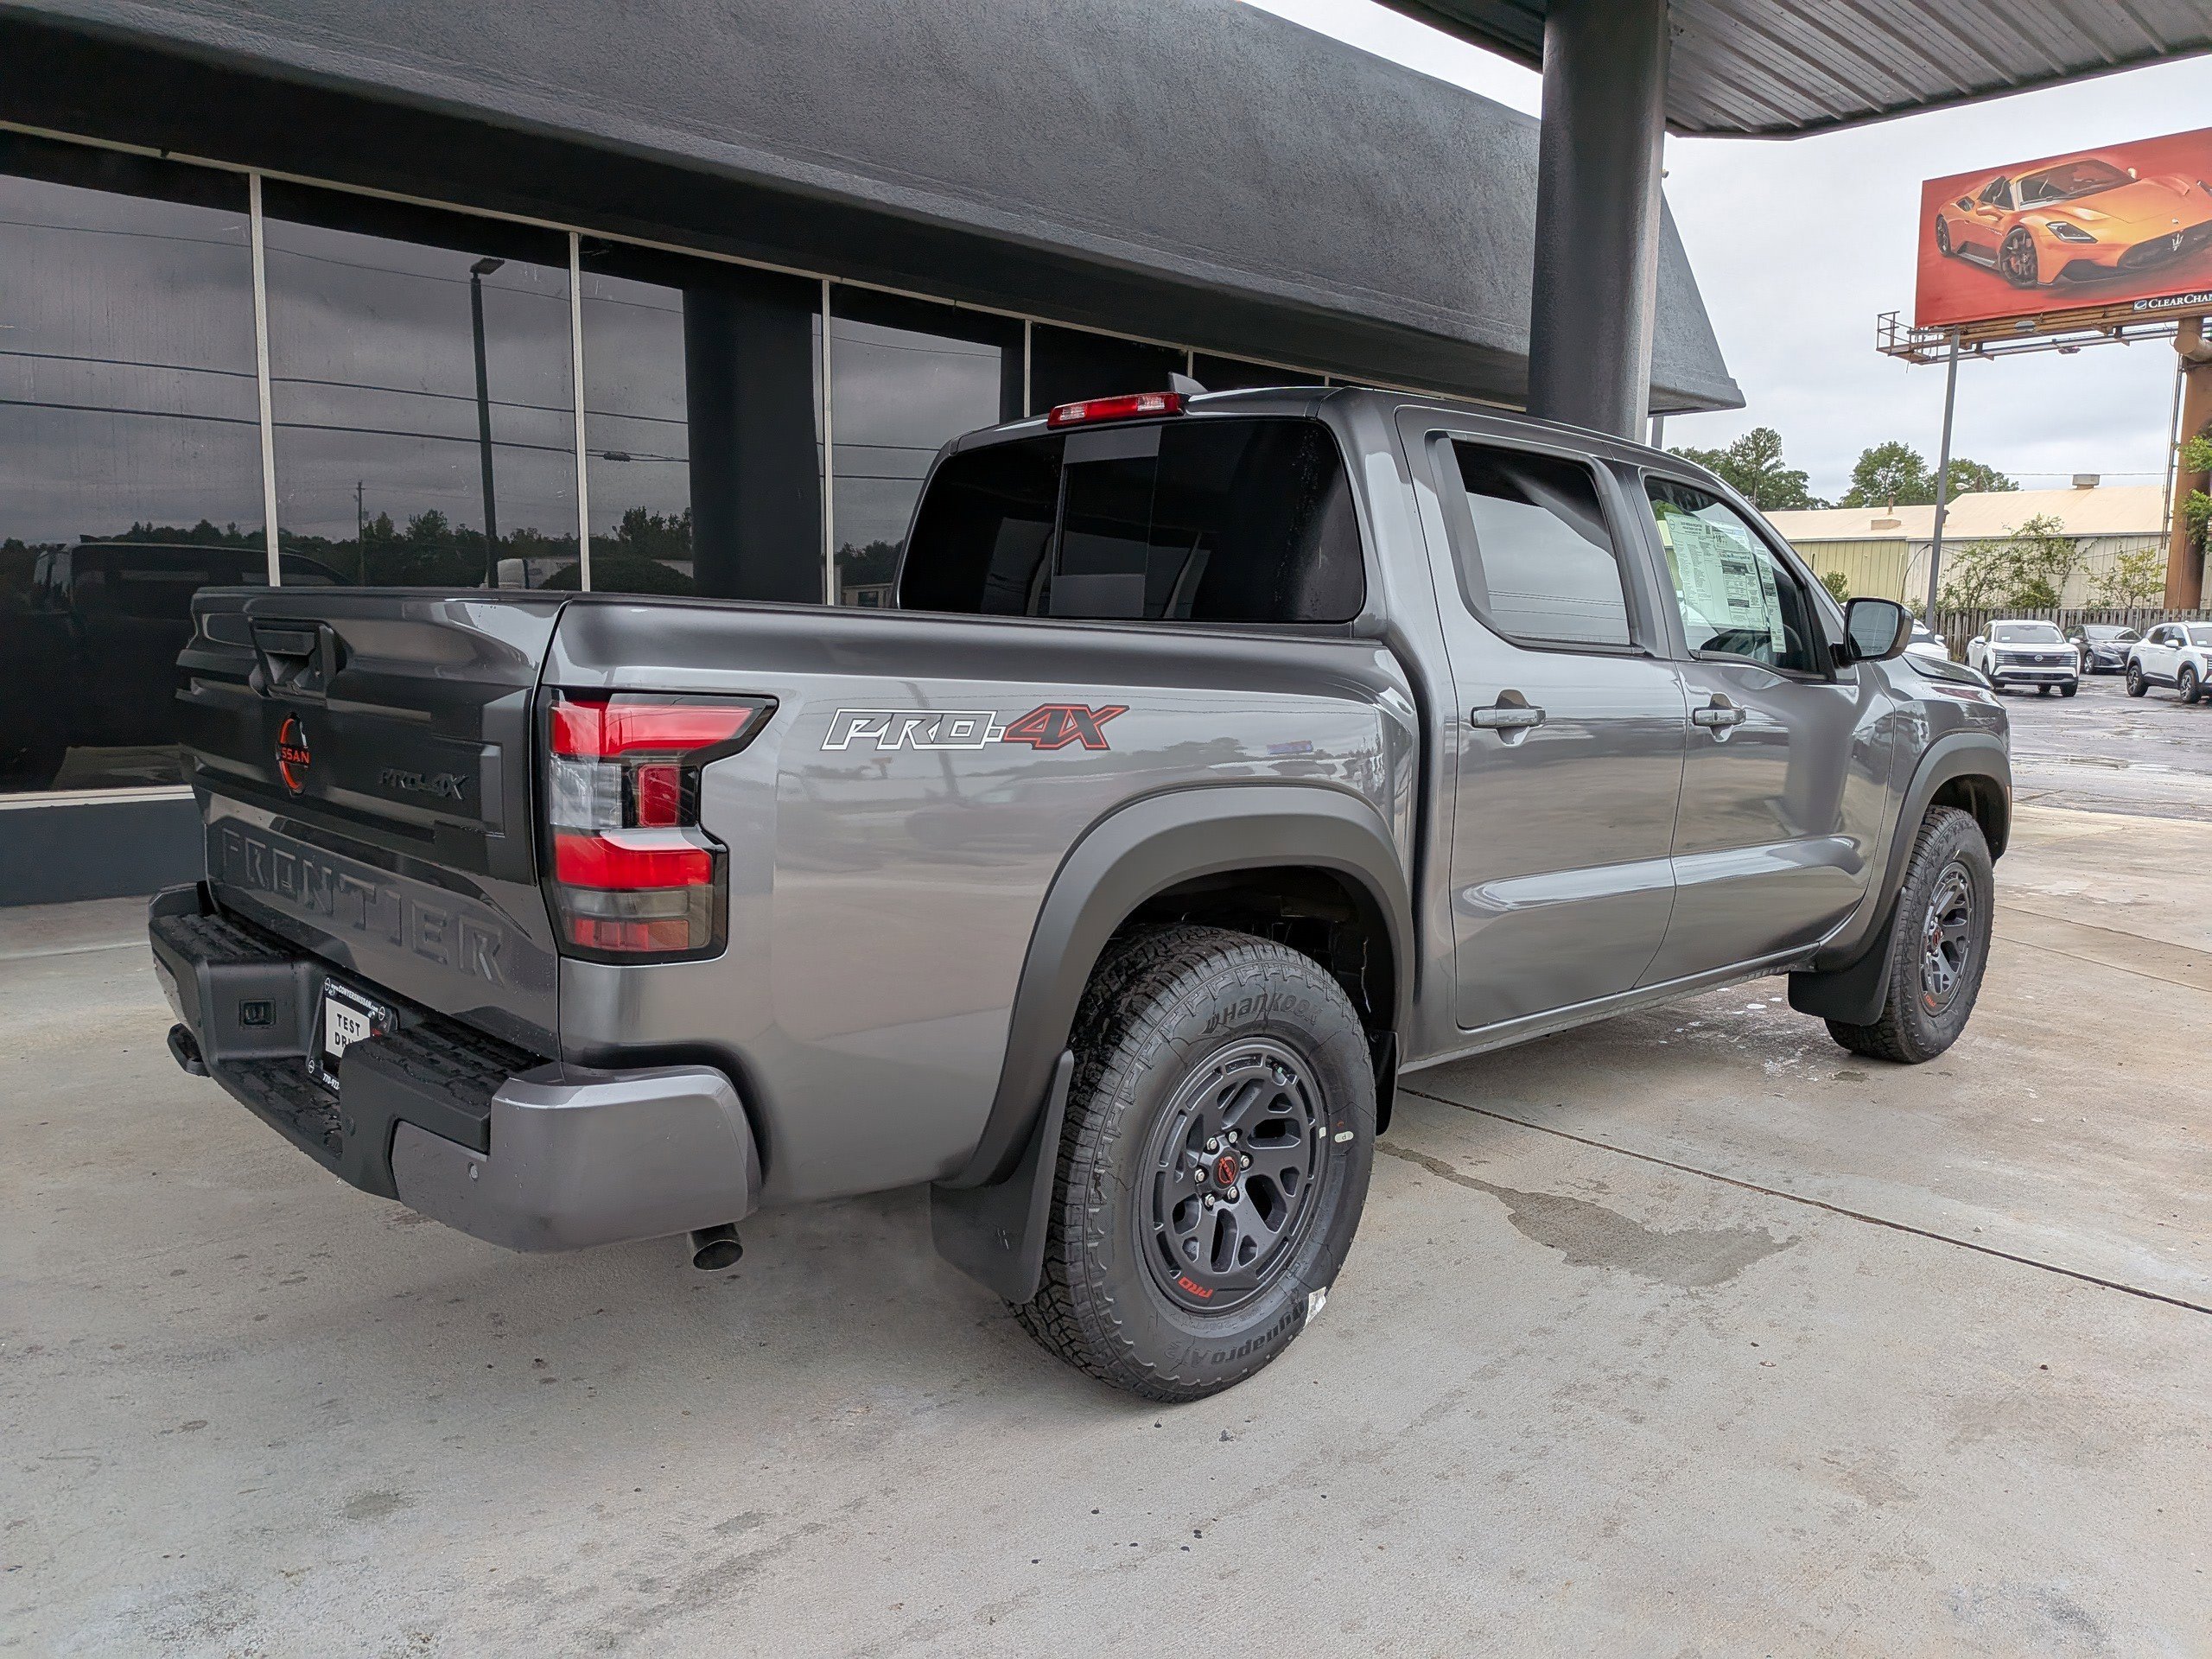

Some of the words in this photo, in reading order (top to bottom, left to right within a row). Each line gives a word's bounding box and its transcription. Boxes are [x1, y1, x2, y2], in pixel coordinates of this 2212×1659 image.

[820, 702, 1130, 751] PRO-4X
[221, 827, 507, 986] FRONTIER
[336, 1013, 361, 1037] TEST
[1178, 1276, 1213, 1298] PRO
